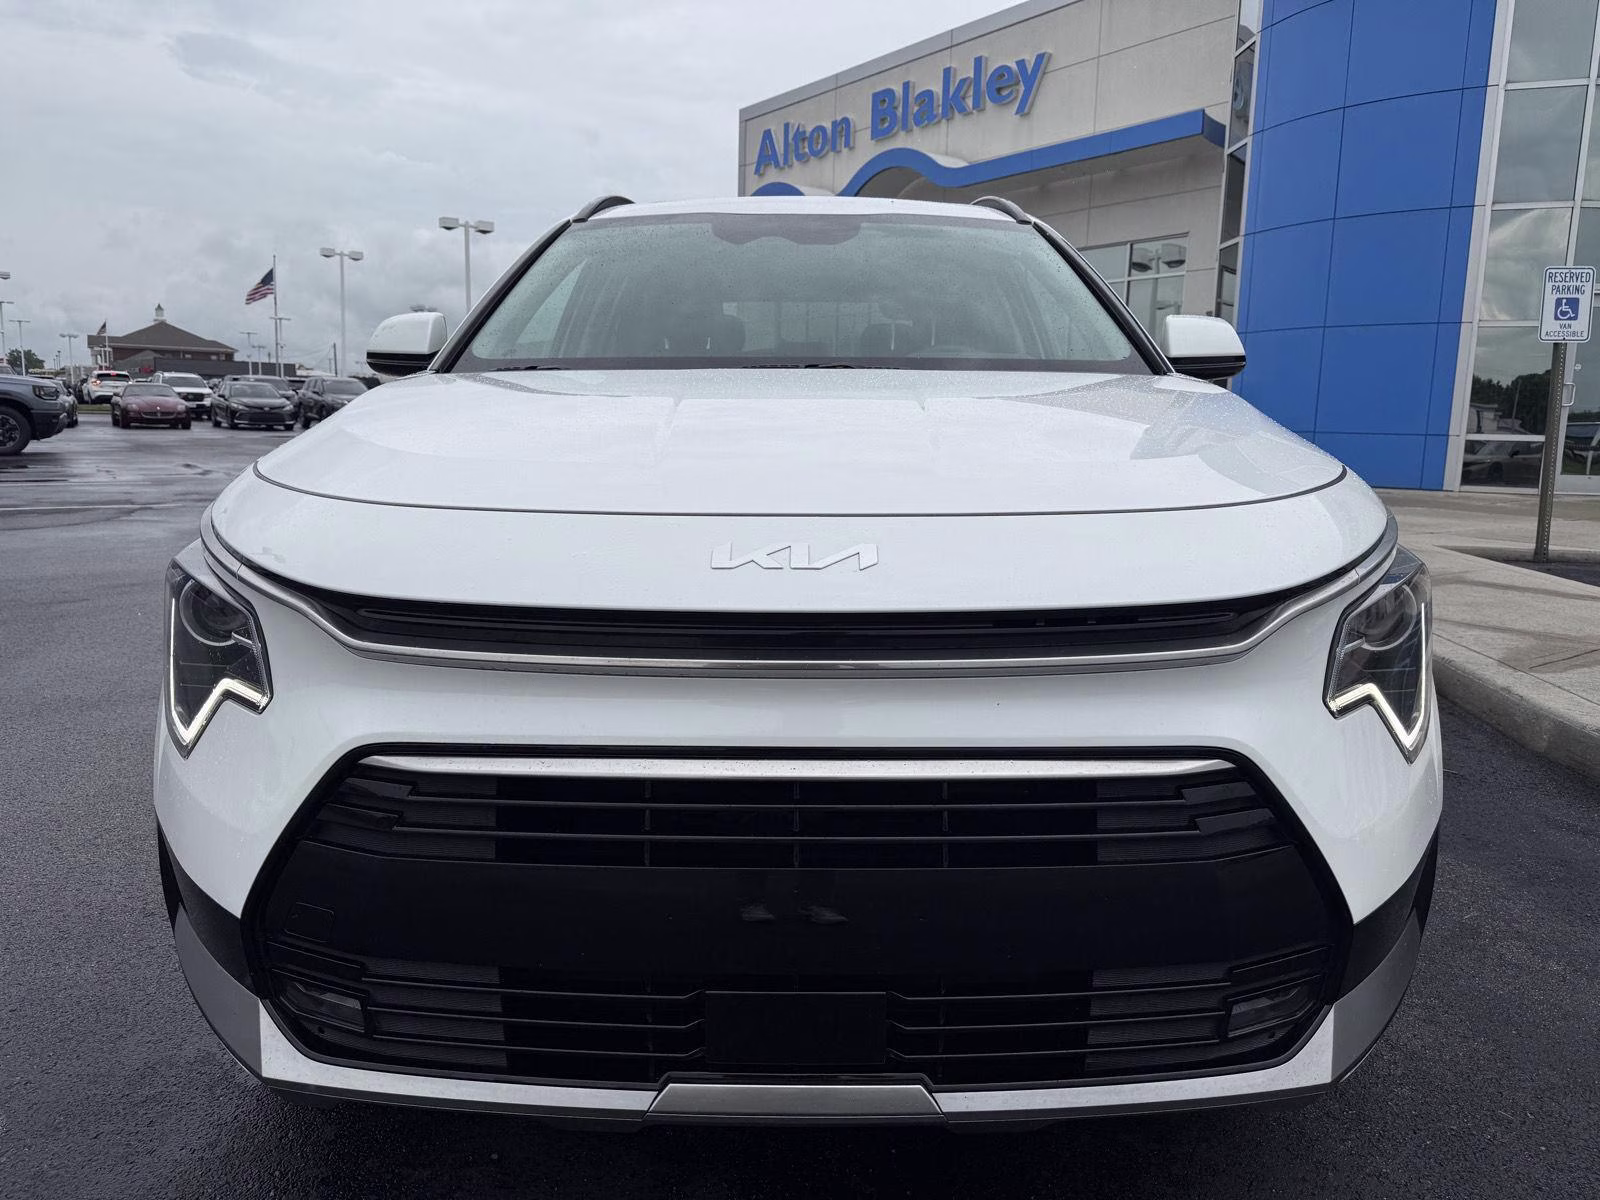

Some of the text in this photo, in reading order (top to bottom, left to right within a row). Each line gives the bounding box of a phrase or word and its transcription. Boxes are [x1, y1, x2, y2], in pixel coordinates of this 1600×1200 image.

[754, 51, 1051, 176] Alton Blakley
[1547, 271, 1591, 283] RESERVED
[1551, 284, 1586, 295] PARKING
[1559, 322, 1572, 330] VAN
[1544, 330, 1585, 338] ACCESSIBLE
